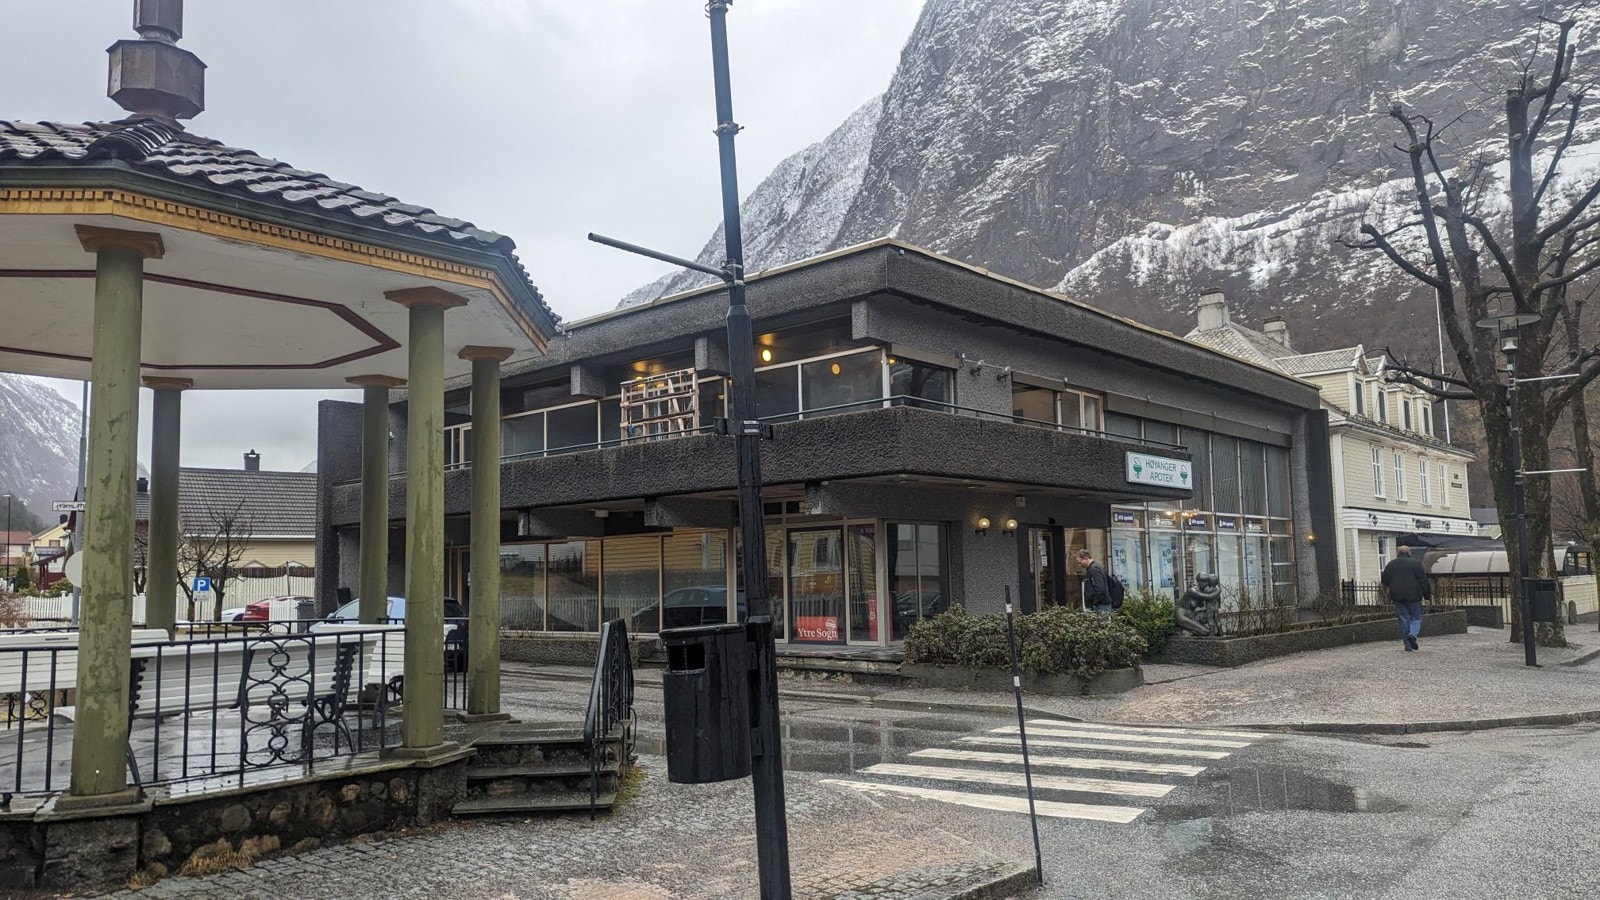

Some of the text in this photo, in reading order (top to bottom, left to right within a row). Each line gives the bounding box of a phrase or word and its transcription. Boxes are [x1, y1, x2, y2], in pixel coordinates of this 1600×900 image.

[1145, 459, 1177, 472] HØYANGER
[1149, 472, 1174, 483] APOTEK
[197, 579, 206, 591] P
[798, 628, 838, 641] Ytre Sogn
